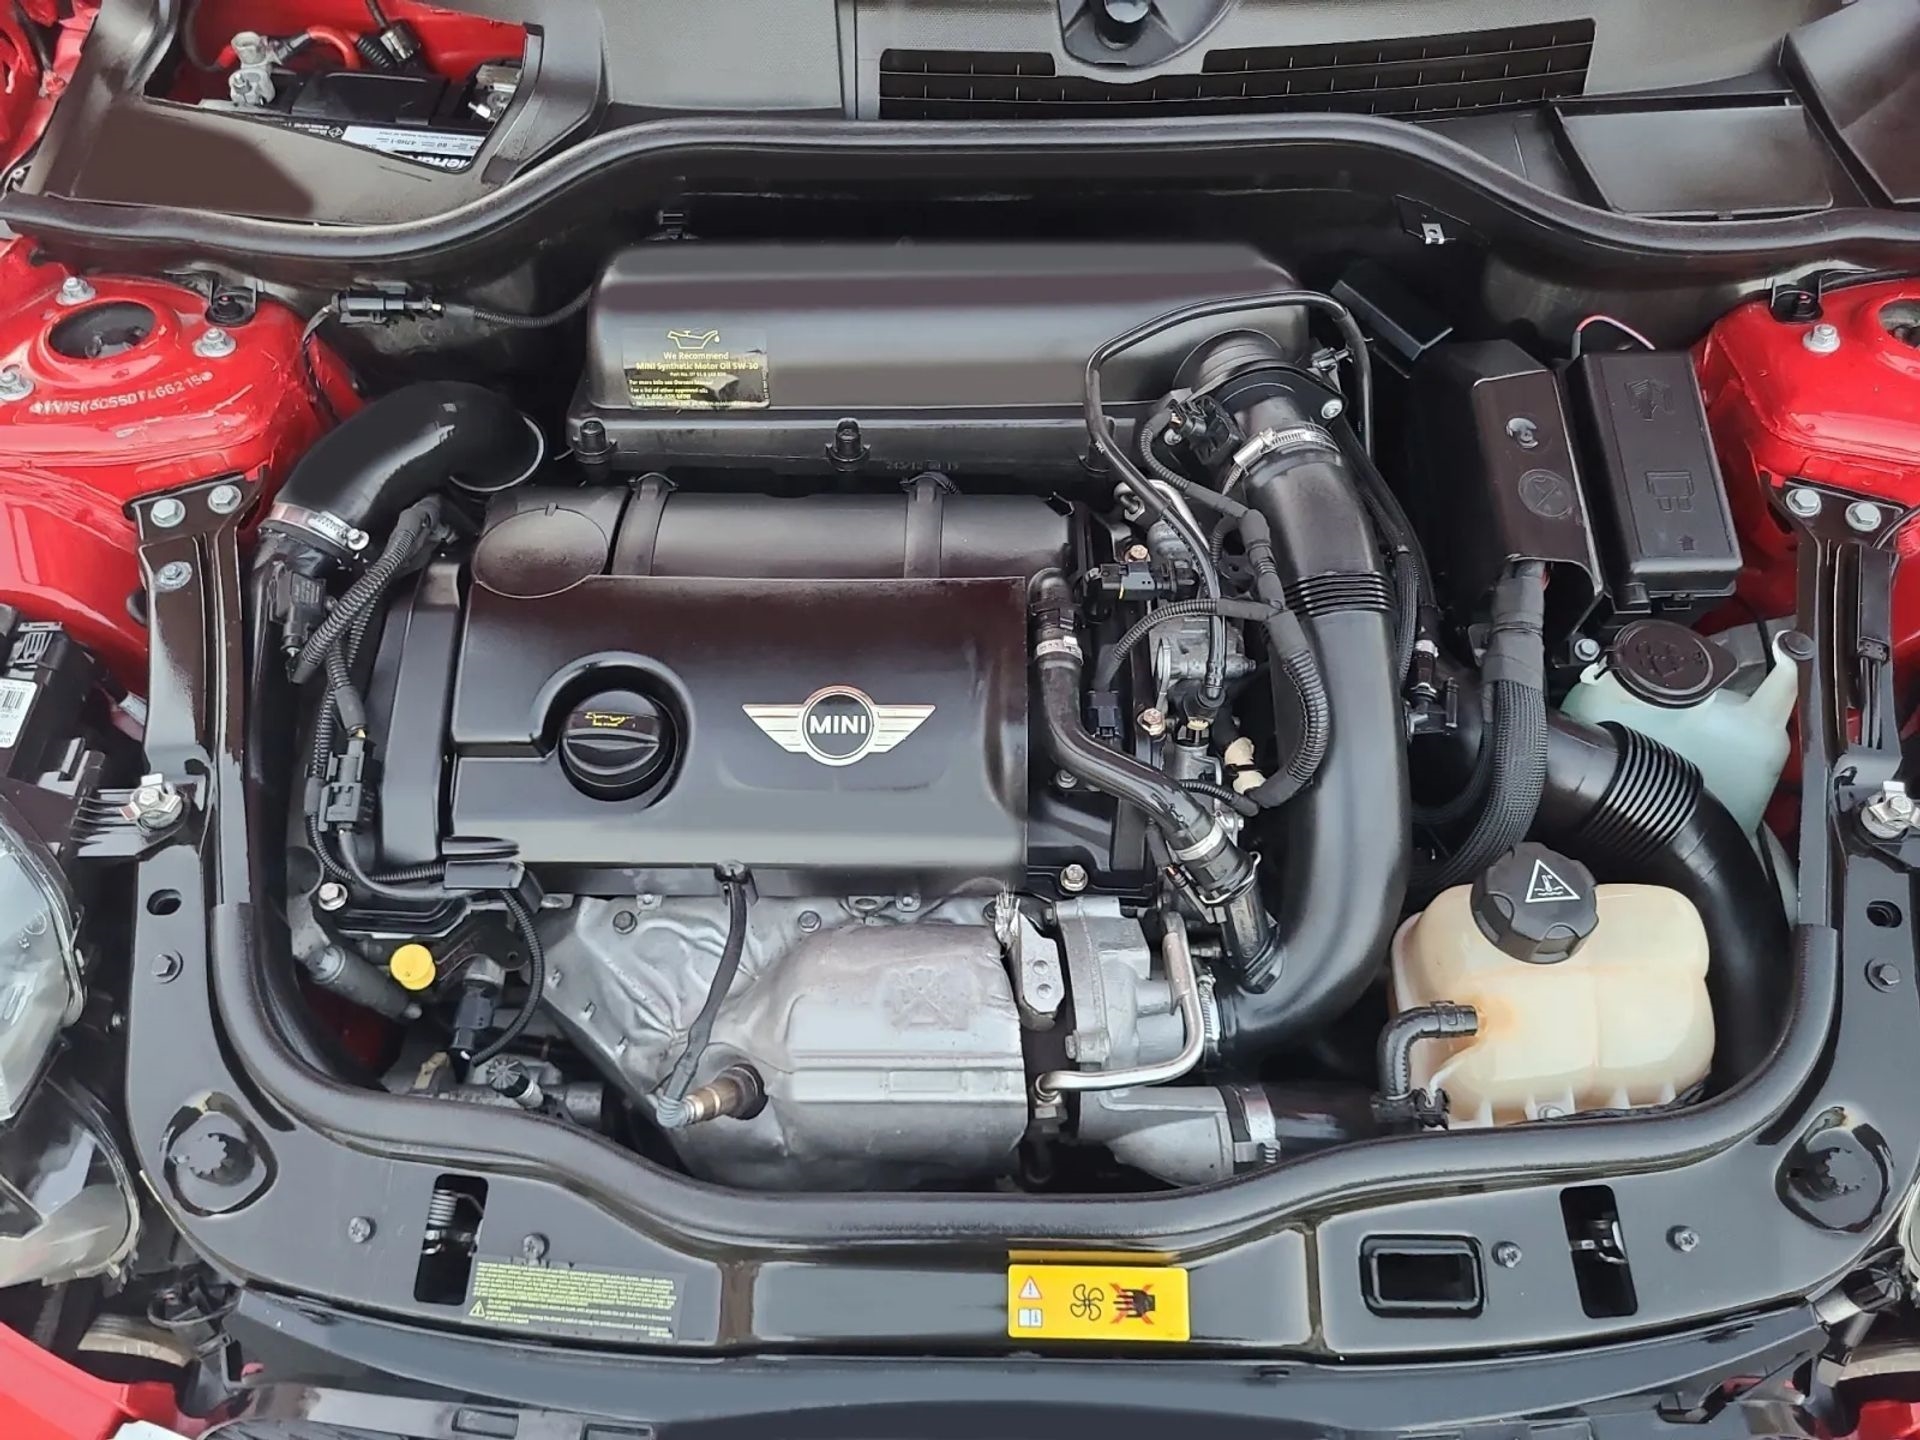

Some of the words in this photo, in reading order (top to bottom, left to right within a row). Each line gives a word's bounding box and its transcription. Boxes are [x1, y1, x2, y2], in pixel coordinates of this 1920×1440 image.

[664, 352, 676, 360] We
[679, 352, 729, 360] Recommend
[657, 362, 693, 372] Synthetic
[719, 362, 731, 370] Oil
[810, 715, 867, 734] MINI
